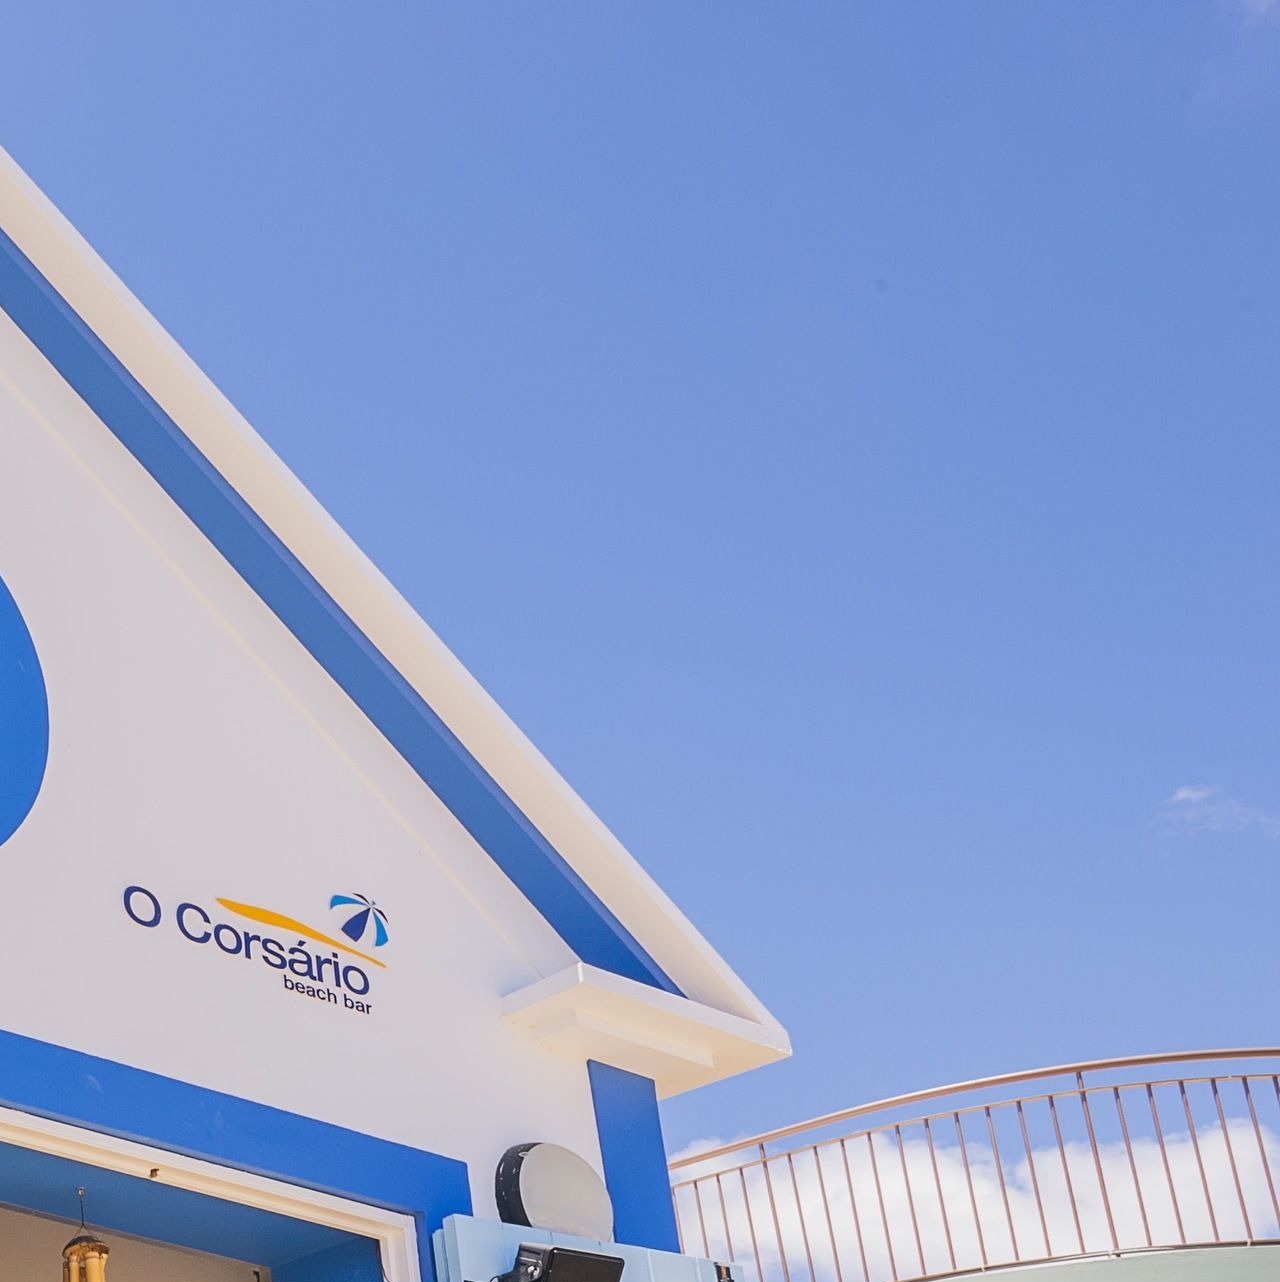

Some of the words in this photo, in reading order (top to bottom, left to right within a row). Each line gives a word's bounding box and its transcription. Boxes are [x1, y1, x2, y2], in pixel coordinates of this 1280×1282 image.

[123, 885, 162, 927] O
[176, 902, 370, 996] Corsário
[283, 974, 338, 1004] beach
[343, 993, 372, 1014] bar
